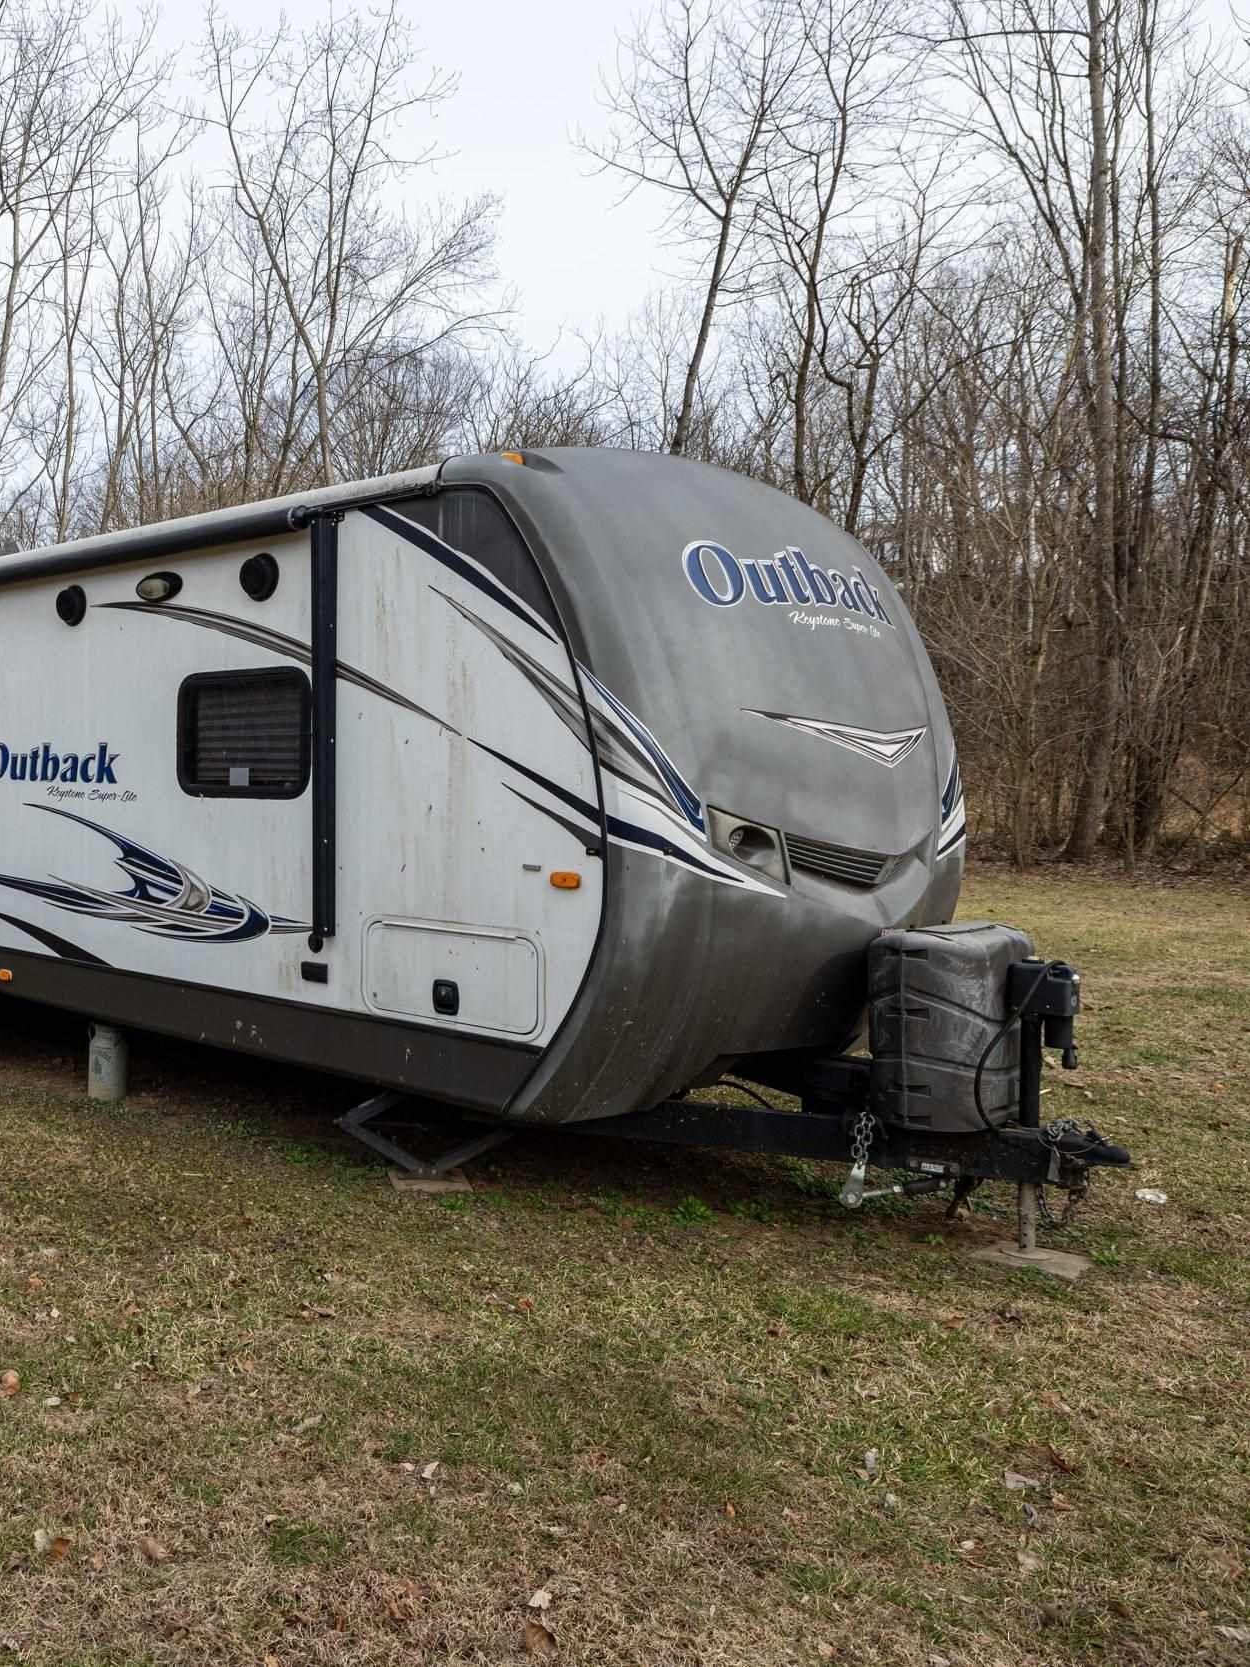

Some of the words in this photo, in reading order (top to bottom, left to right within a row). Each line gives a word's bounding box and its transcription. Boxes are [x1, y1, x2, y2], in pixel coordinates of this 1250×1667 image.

[682, 540, 896, 630] Outback
[788, 611, 841, 631] Keystone
[46, 785, 86, 802] Keystone
